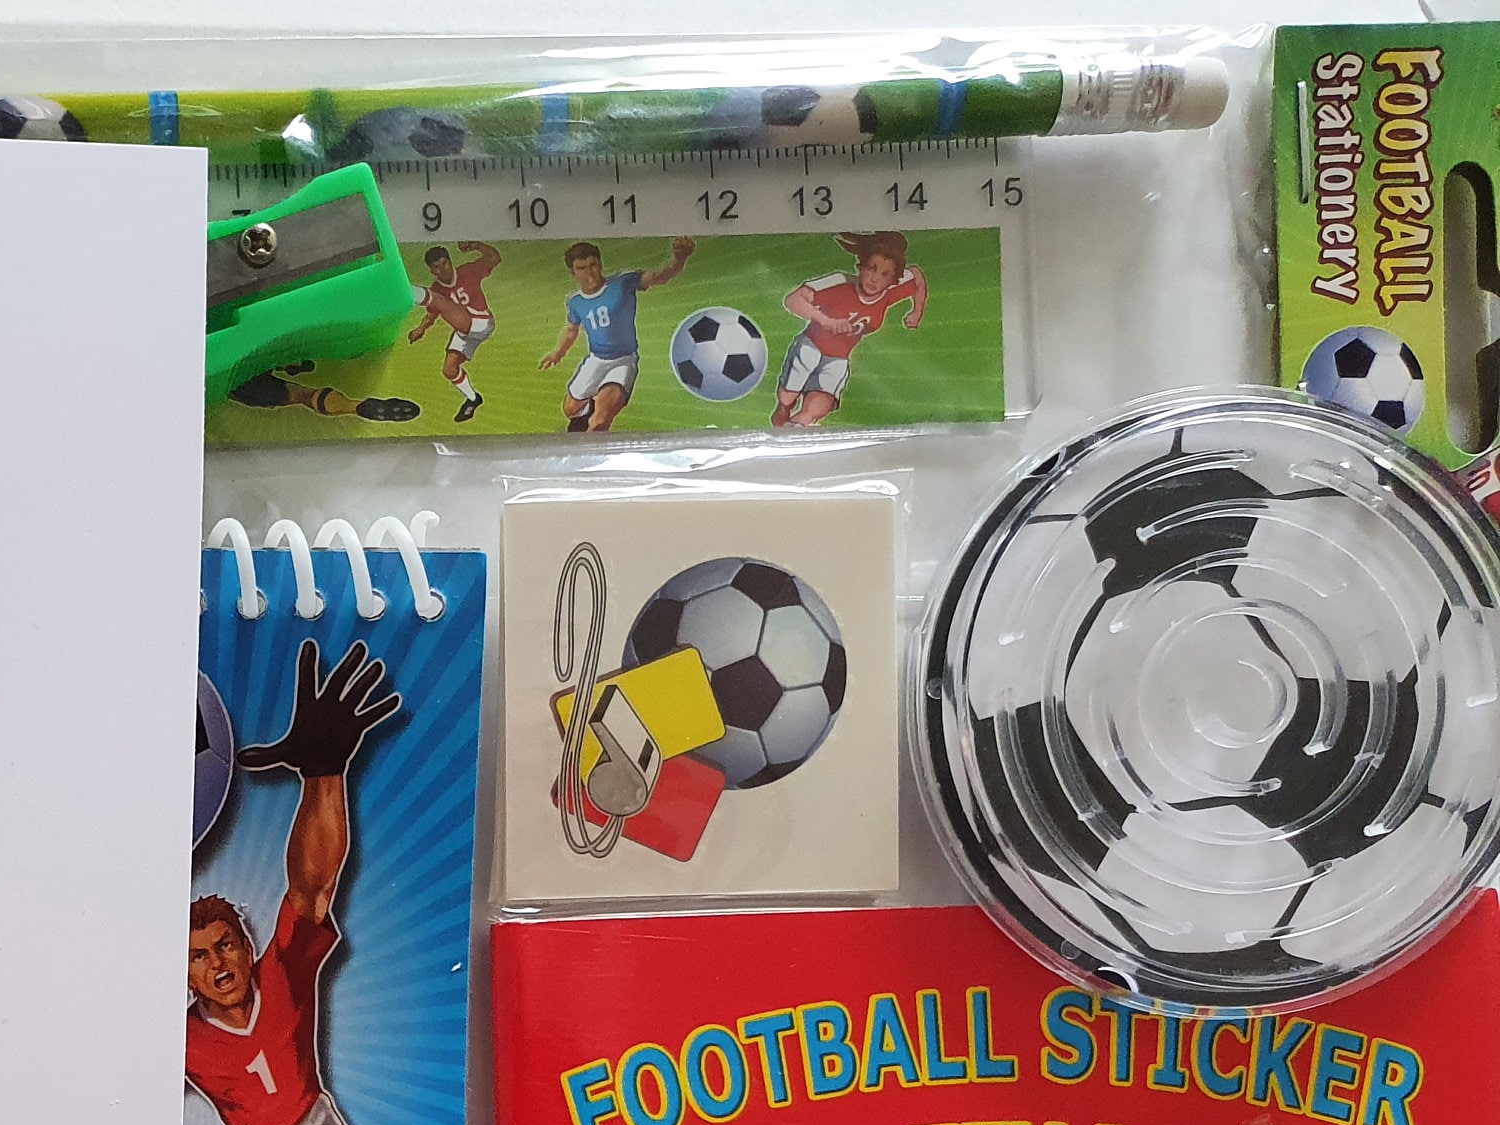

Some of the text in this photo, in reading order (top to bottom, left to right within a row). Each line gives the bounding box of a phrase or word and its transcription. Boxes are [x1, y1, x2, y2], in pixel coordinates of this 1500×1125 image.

[421, 177, 1024, 232] 9 10 11 12 13 14 15
[1311, 50, 1365, 306] Stationery
[1373, 45, 1444, 318] FOOTBALL
[586, 305, 611, 330] 18
[244, 1048, 278, 1095] 1
